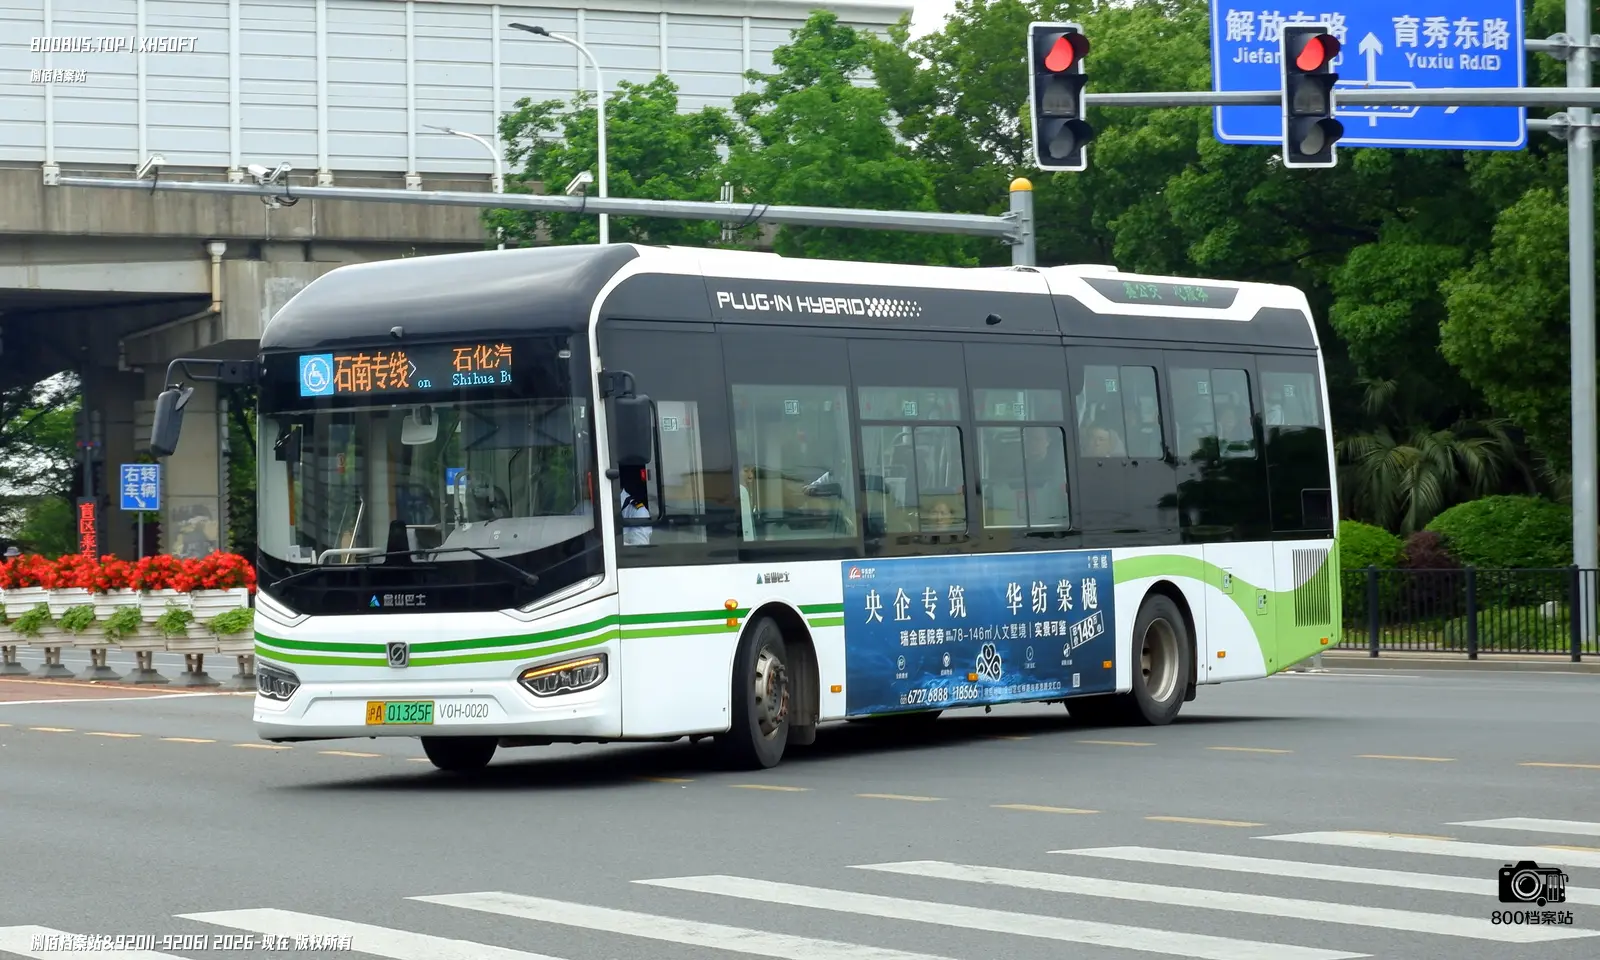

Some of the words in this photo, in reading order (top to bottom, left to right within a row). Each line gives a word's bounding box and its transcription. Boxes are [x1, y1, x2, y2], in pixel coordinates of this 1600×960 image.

[1225, 9, 1348, 45] 解放路
[1392, 14, 1511, 50] 育秀东路
[1405, 52, 1454, 69] Yuxiu
[1459, 54, 1501, 71] Rd.(E)
[716, 291, 793, 312] PLUG-IN
[796, 296, 865, 315] HYBRID
[453, 343, 512, 371] 石化汽
[334, 352, 409, 392] 石南专线
[453, 371, 495, 386] Shihua
[418, 379, 431, 388] on
[124, 467, 156, 482] 右转
[124, 483, 156, 498] 车辆
[865, 585, 967, 624] 央企专筑
[1005, 577, 1098, 616] 华纺棠樾
[900, 628, 944, 646] 瑞金医院旁
[1034, 620, 1067, 638] 实景可鉴
[908, 689, 927, 704] 6727
[928, 687, 948, 702] 6888
[388, 704, 432, 721] 01325F
